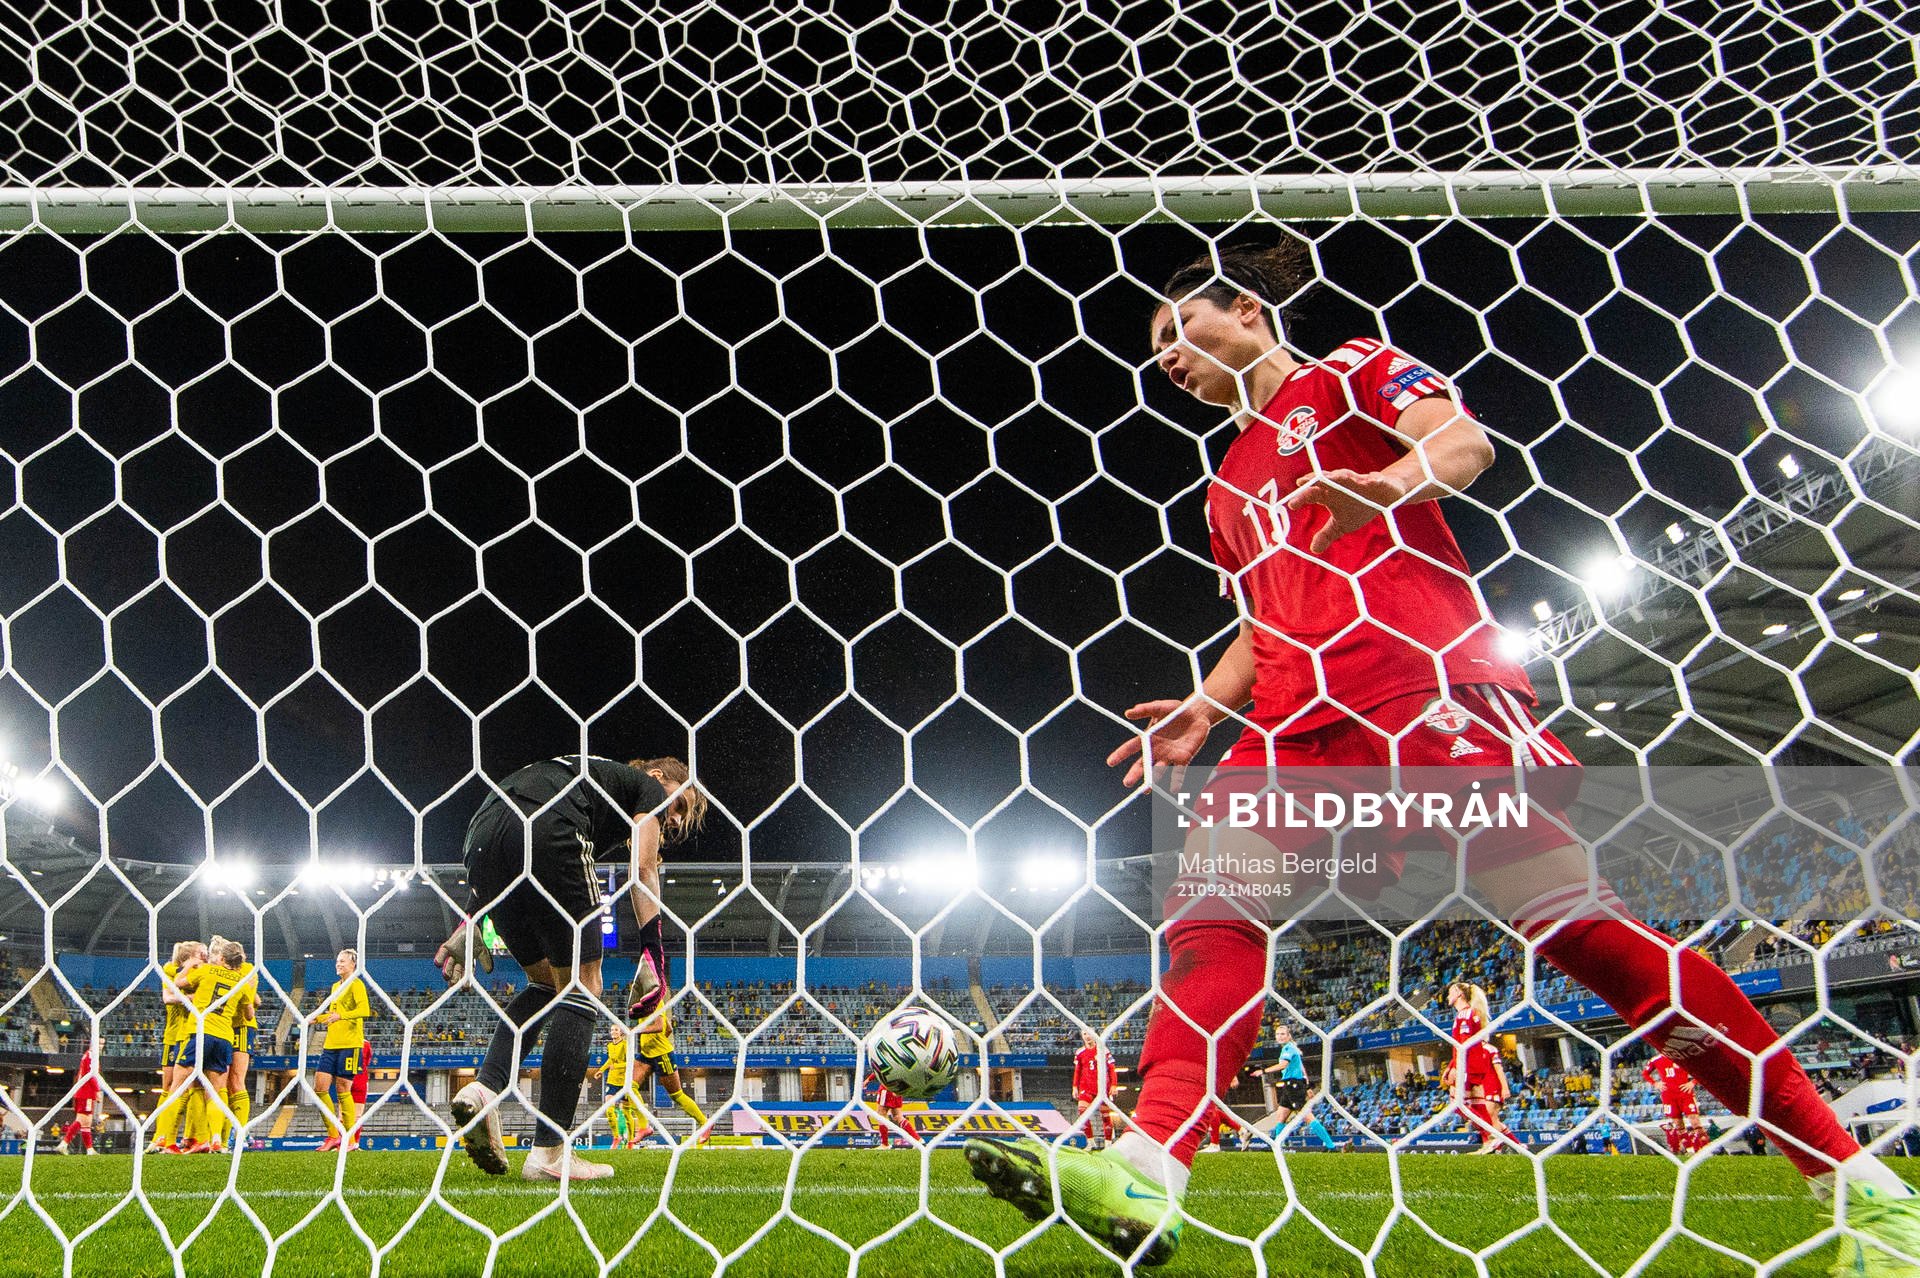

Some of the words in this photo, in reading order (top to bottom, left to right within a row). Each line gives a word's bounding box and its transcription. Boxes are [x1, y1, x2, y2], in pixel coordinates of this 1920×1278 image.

[1242, 477, 1291, 554] 13
[345, 1057, 353, 1071] 8
[1089, 1060, 1095, 1070] 3
